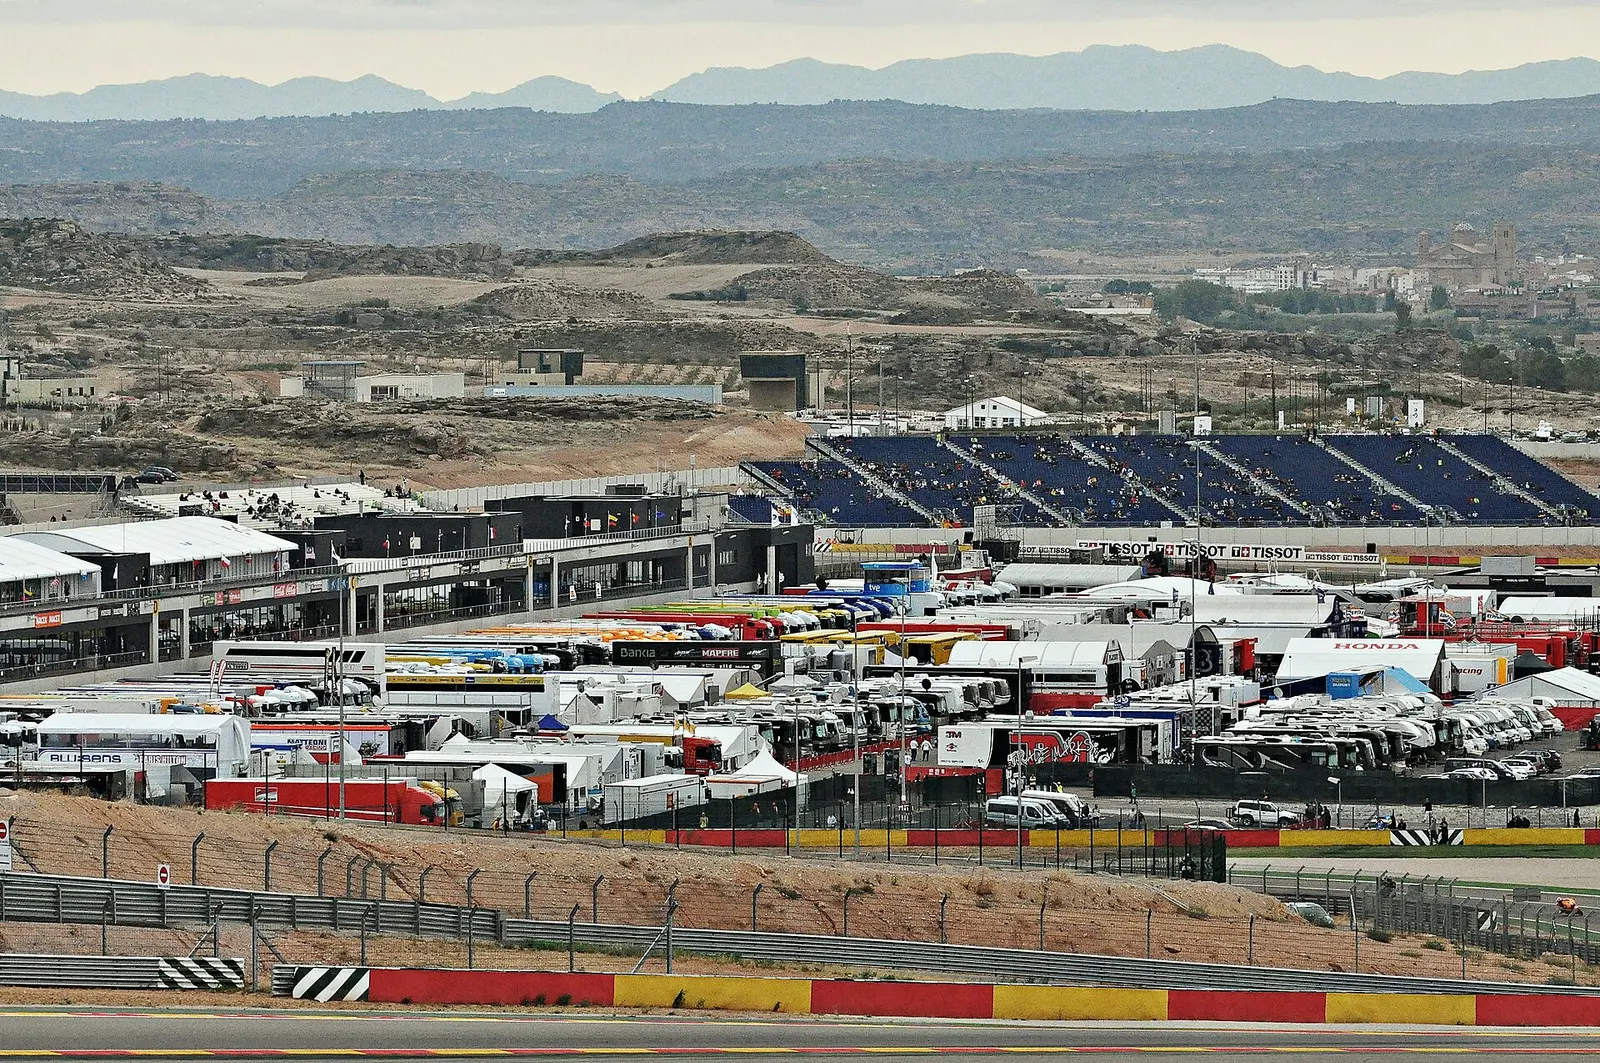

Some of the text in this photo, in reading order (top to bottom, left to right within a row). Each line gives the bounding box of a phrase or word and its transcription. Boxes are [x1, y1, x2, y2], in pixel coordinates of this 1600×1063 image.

[1099, 543, 1150, 555] TISSOT
[1176, 545, 1226, 557] TISSOT
[1252, 547, 1302, 558] TISSOT
[869, 584, 881, 592] tve
[620, 648, 656, 657] Bankia
[163, 755, 187, 764] HILTON
